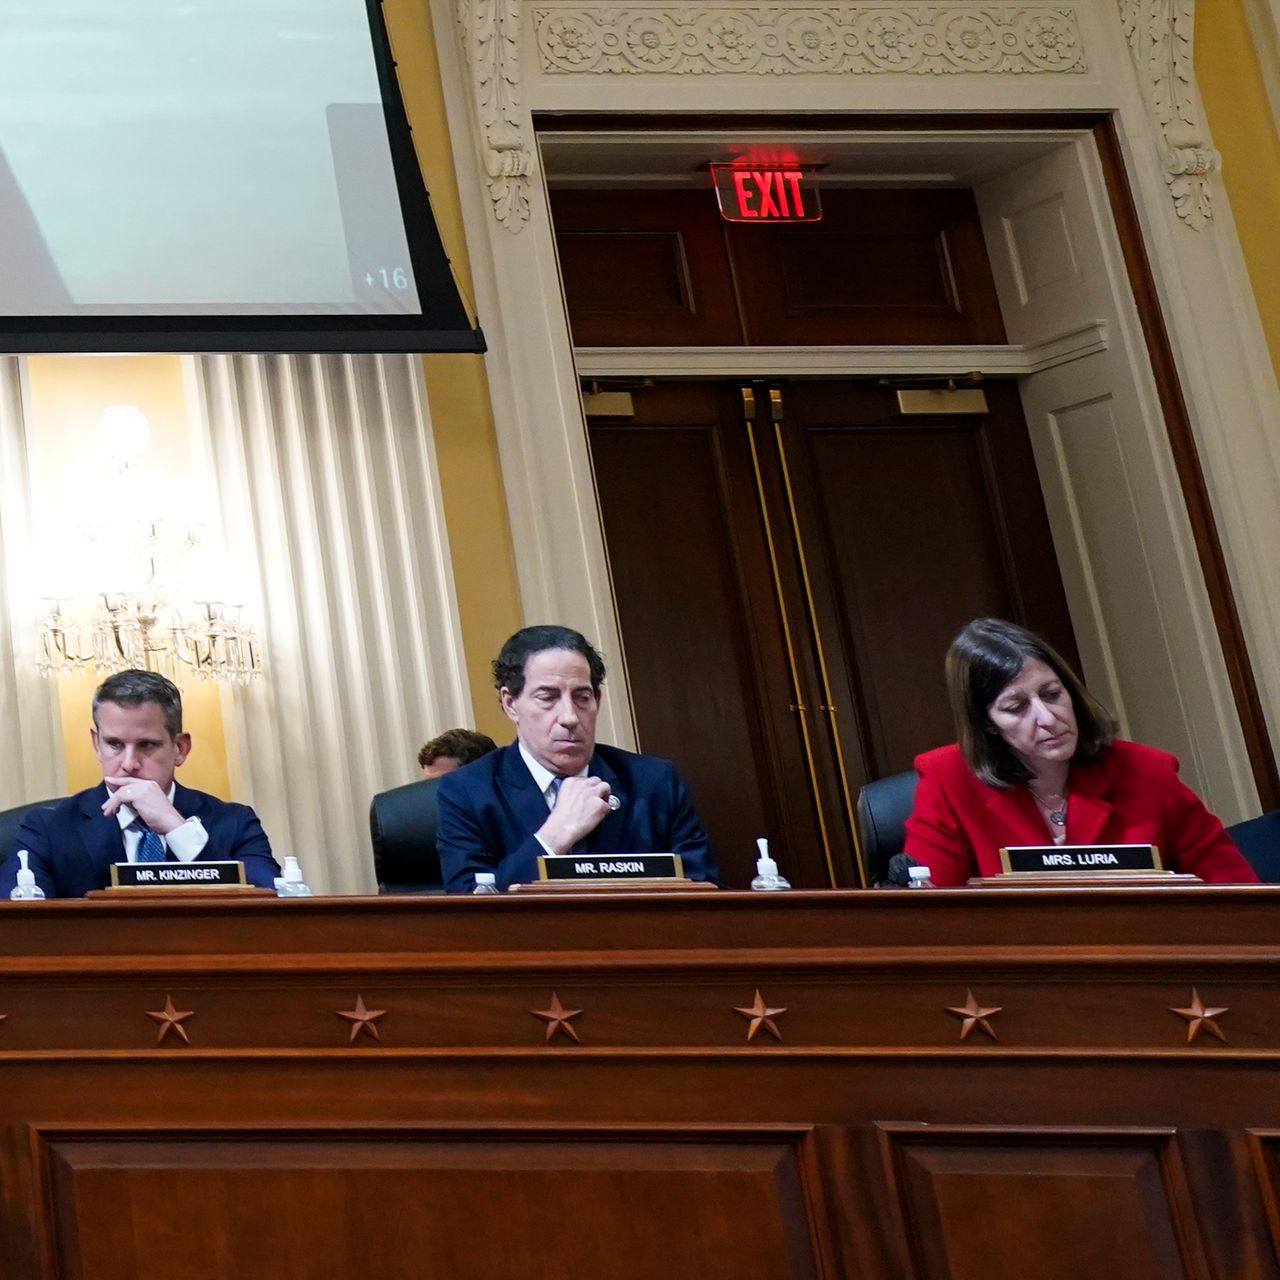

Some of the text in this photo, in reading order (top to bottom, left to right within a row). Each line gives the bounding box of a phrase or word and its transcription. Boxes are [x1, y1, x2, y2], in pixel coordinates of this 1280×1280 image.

[733, 172, 805, 217] EXIT
[363, 267, 408, 289] +16
[1042, 853, 1119, 866] MRS. LURIA
[575, 862, 644, 874] MR. RASKIN
[136, 869, 220, 881] MR. KINZINGER
